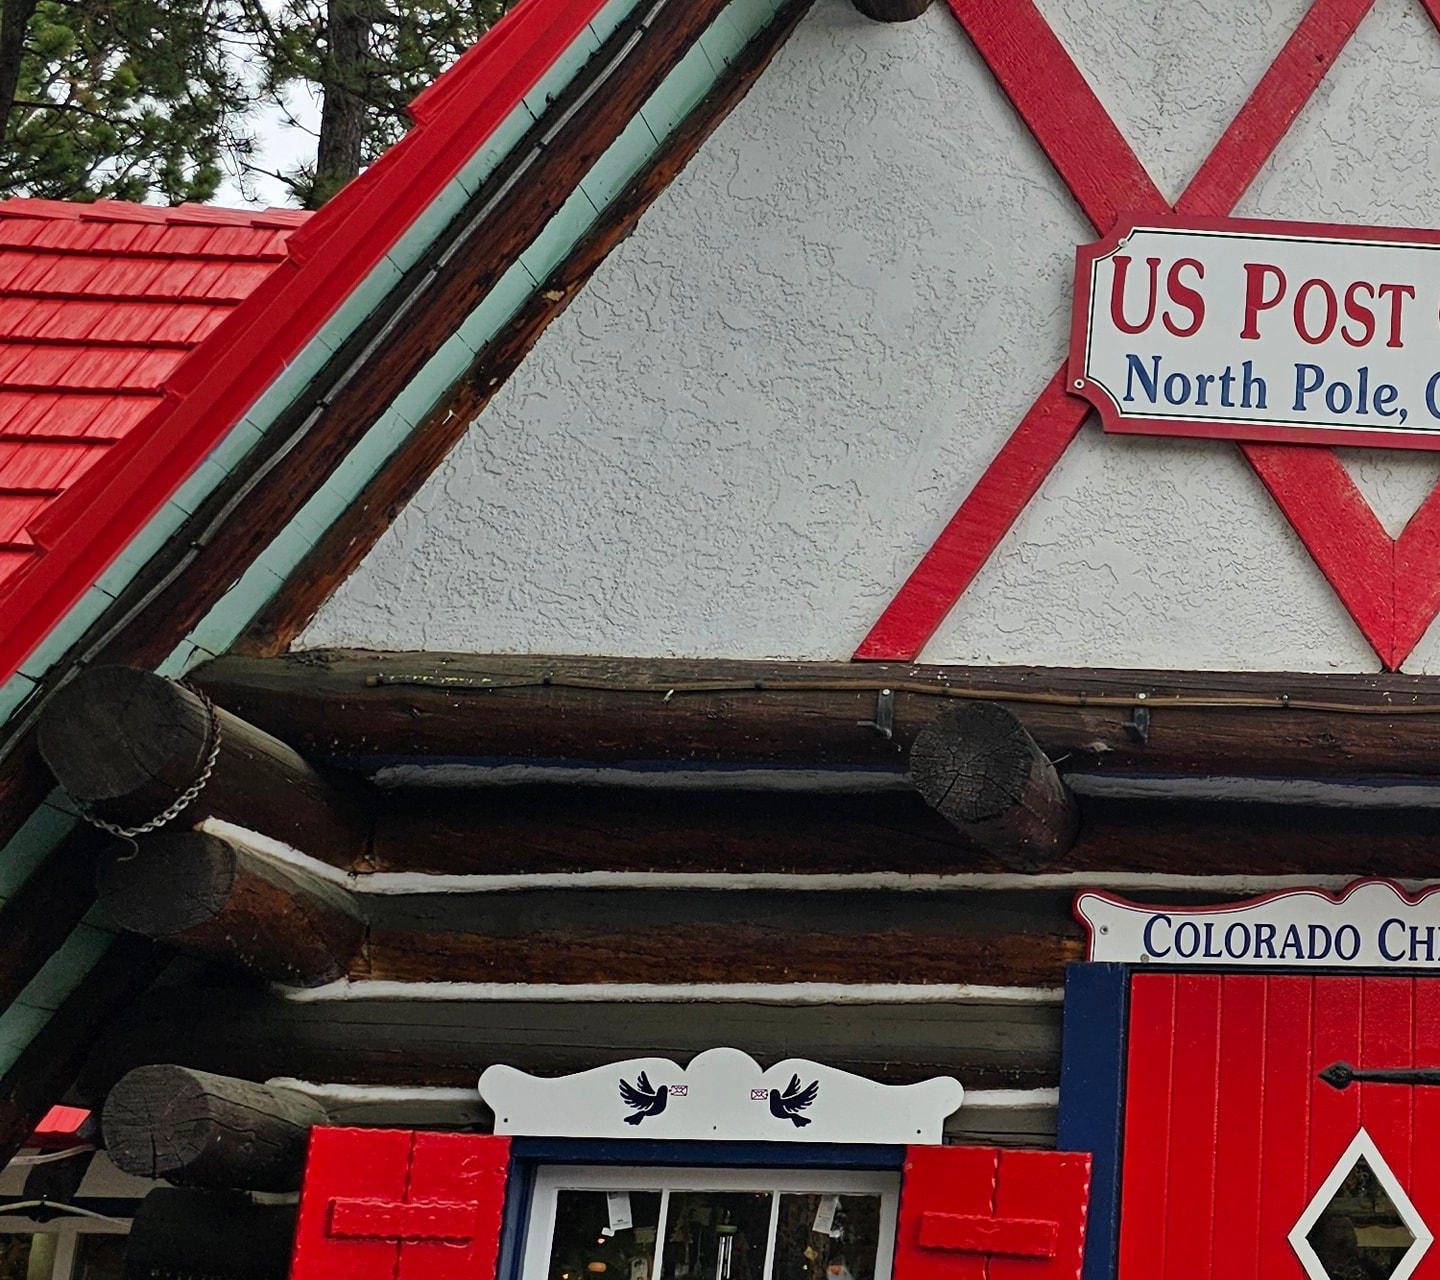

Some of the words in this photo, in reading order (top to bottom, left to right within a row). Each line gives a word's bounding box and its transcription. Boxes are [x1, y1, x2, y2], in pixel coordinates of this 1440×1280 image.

[1109, 255, 1206, 338] US
[1239, 262, 1416, 349] POST
[1122, 353, 1268, 409] North
[1291, 362, 1409, 425] Pole,
[1143, 913, 1362, 961] COLORADO
